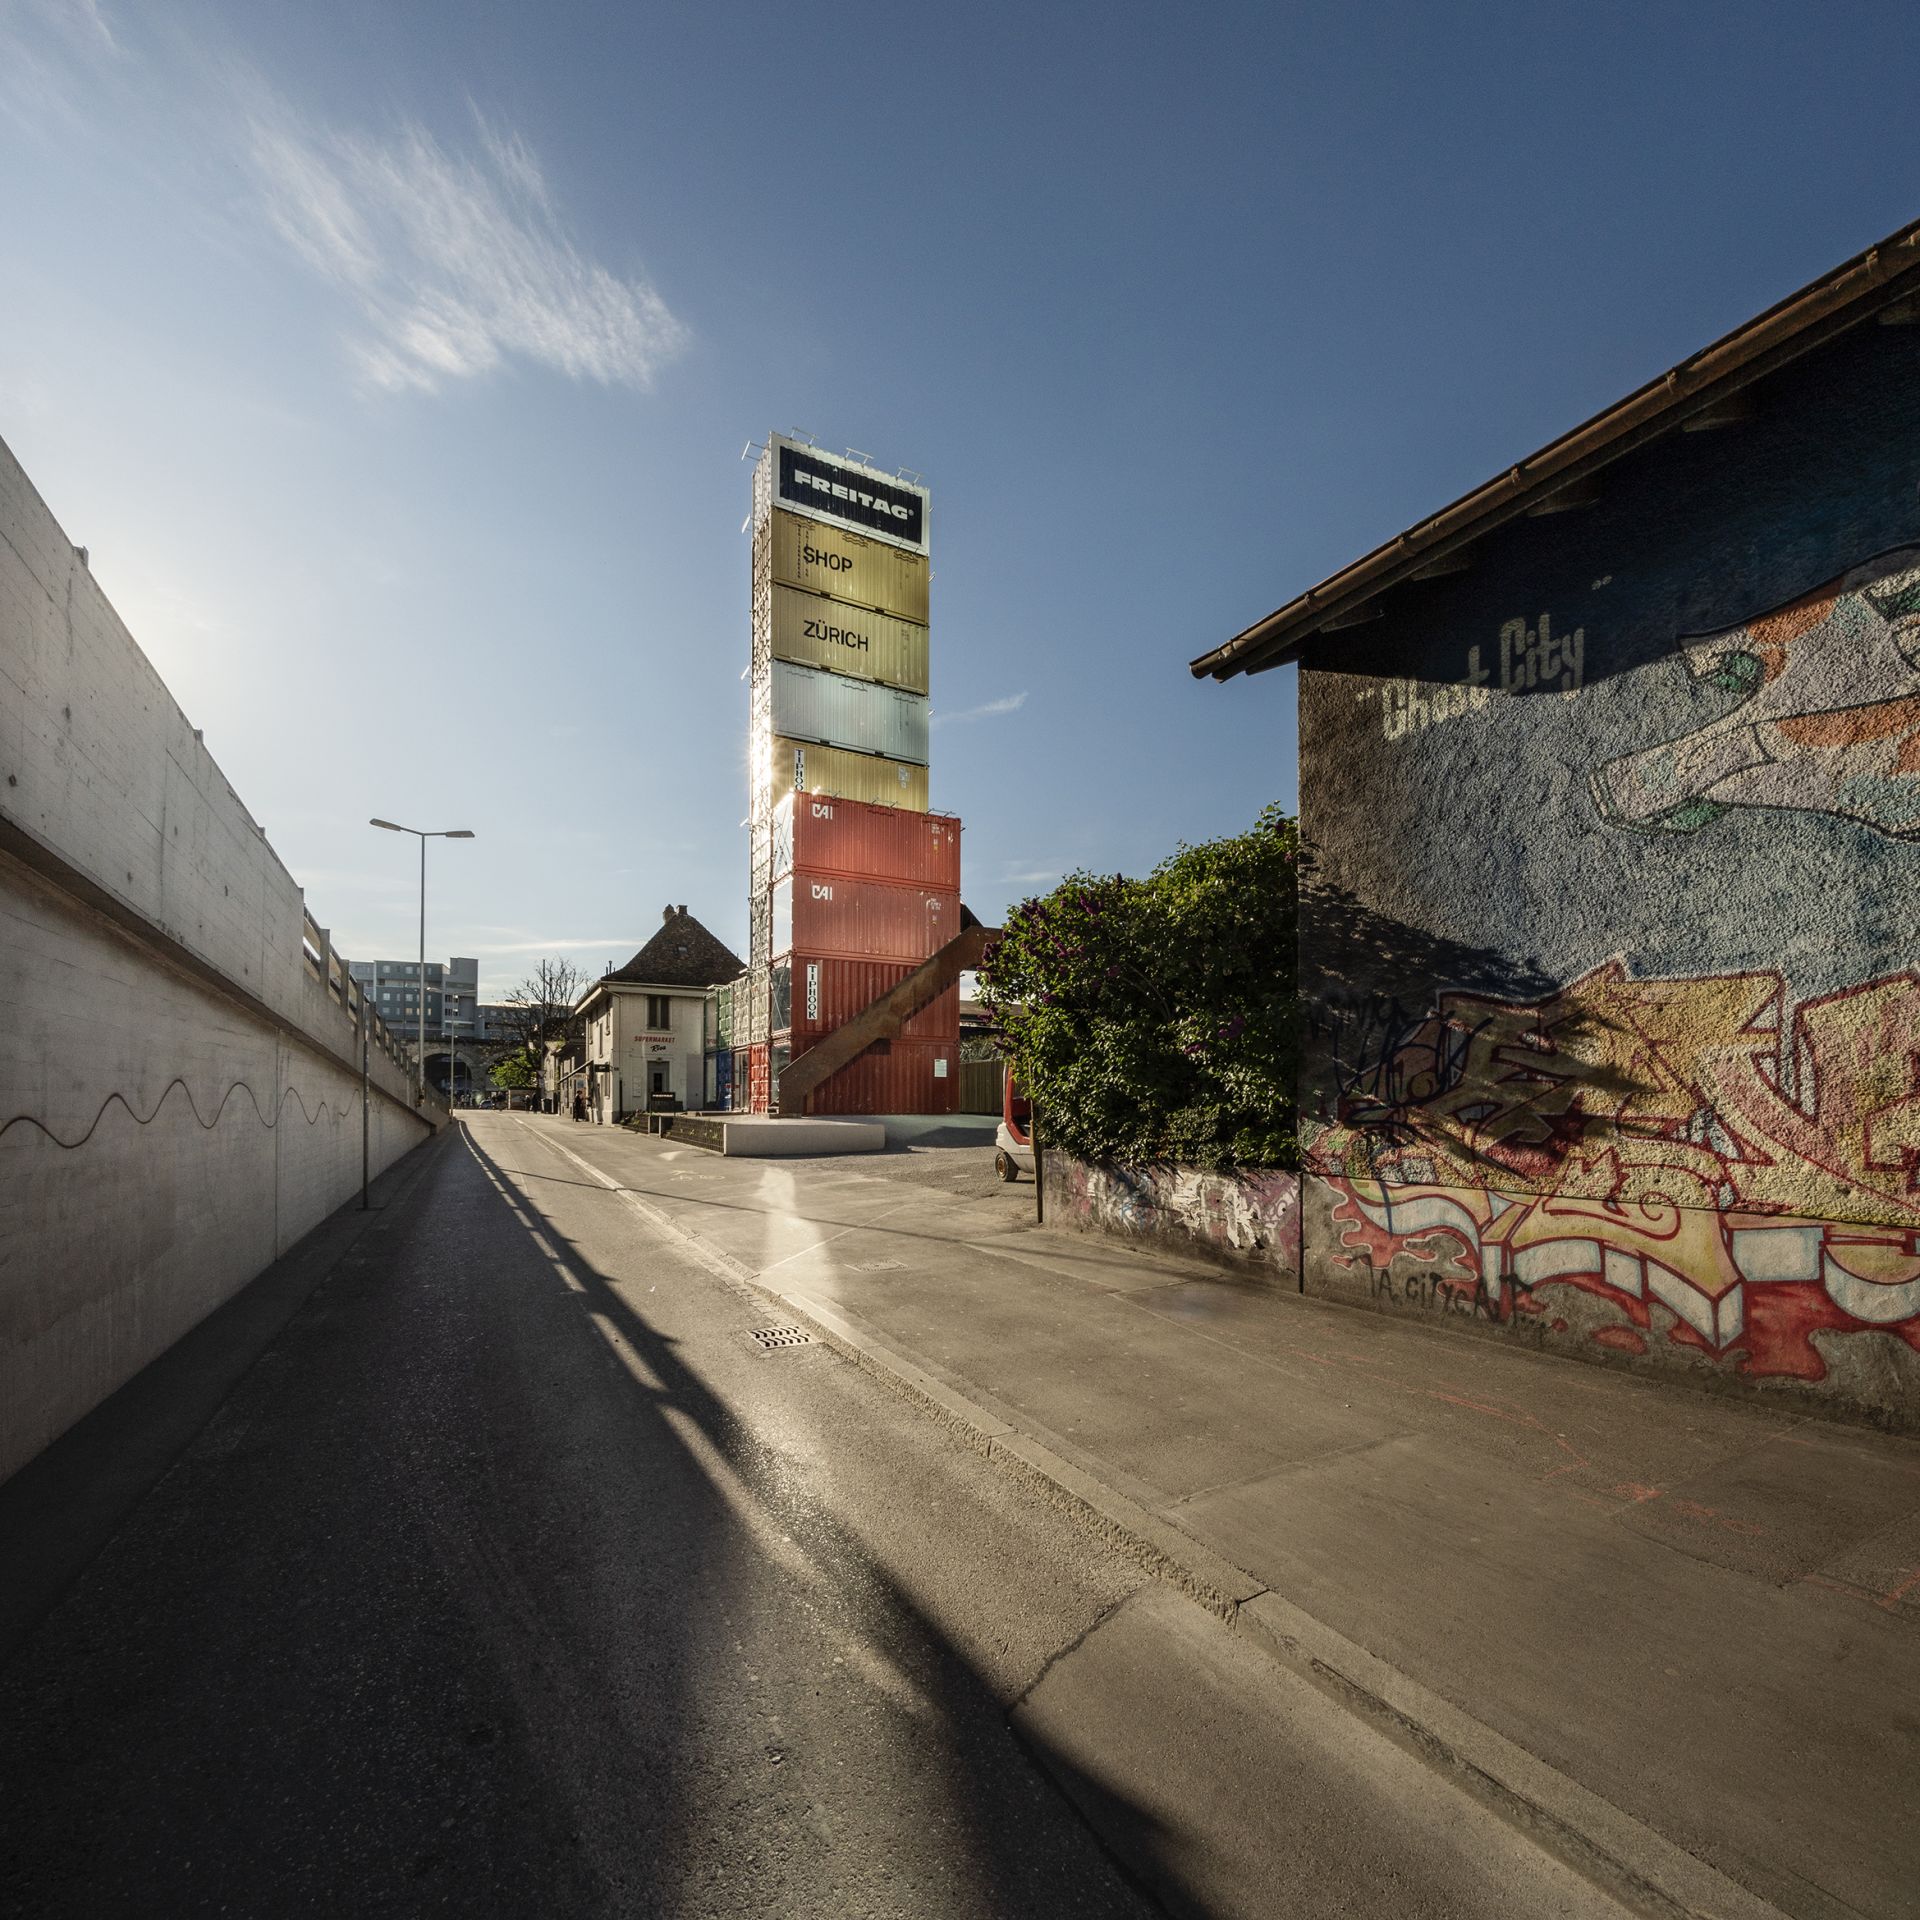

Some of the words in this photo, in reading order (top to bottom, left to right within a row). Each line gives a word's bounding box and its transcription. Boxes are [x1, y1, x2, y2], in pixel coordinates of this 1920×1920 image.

[794, 469, 908, 520] FREITAG
[803, 545, 853, 573] SHOP
[803, 619, 869, 653] ZÜRICH
[1500, 612, 1585, 702] City
[811, 803, 833, 820] CAI
[811, 884, 833, 901] CAI
[808, 965, 817, 1019] TIPHOOK
[634, 1035, 675, 1044] SUPERMARKET
